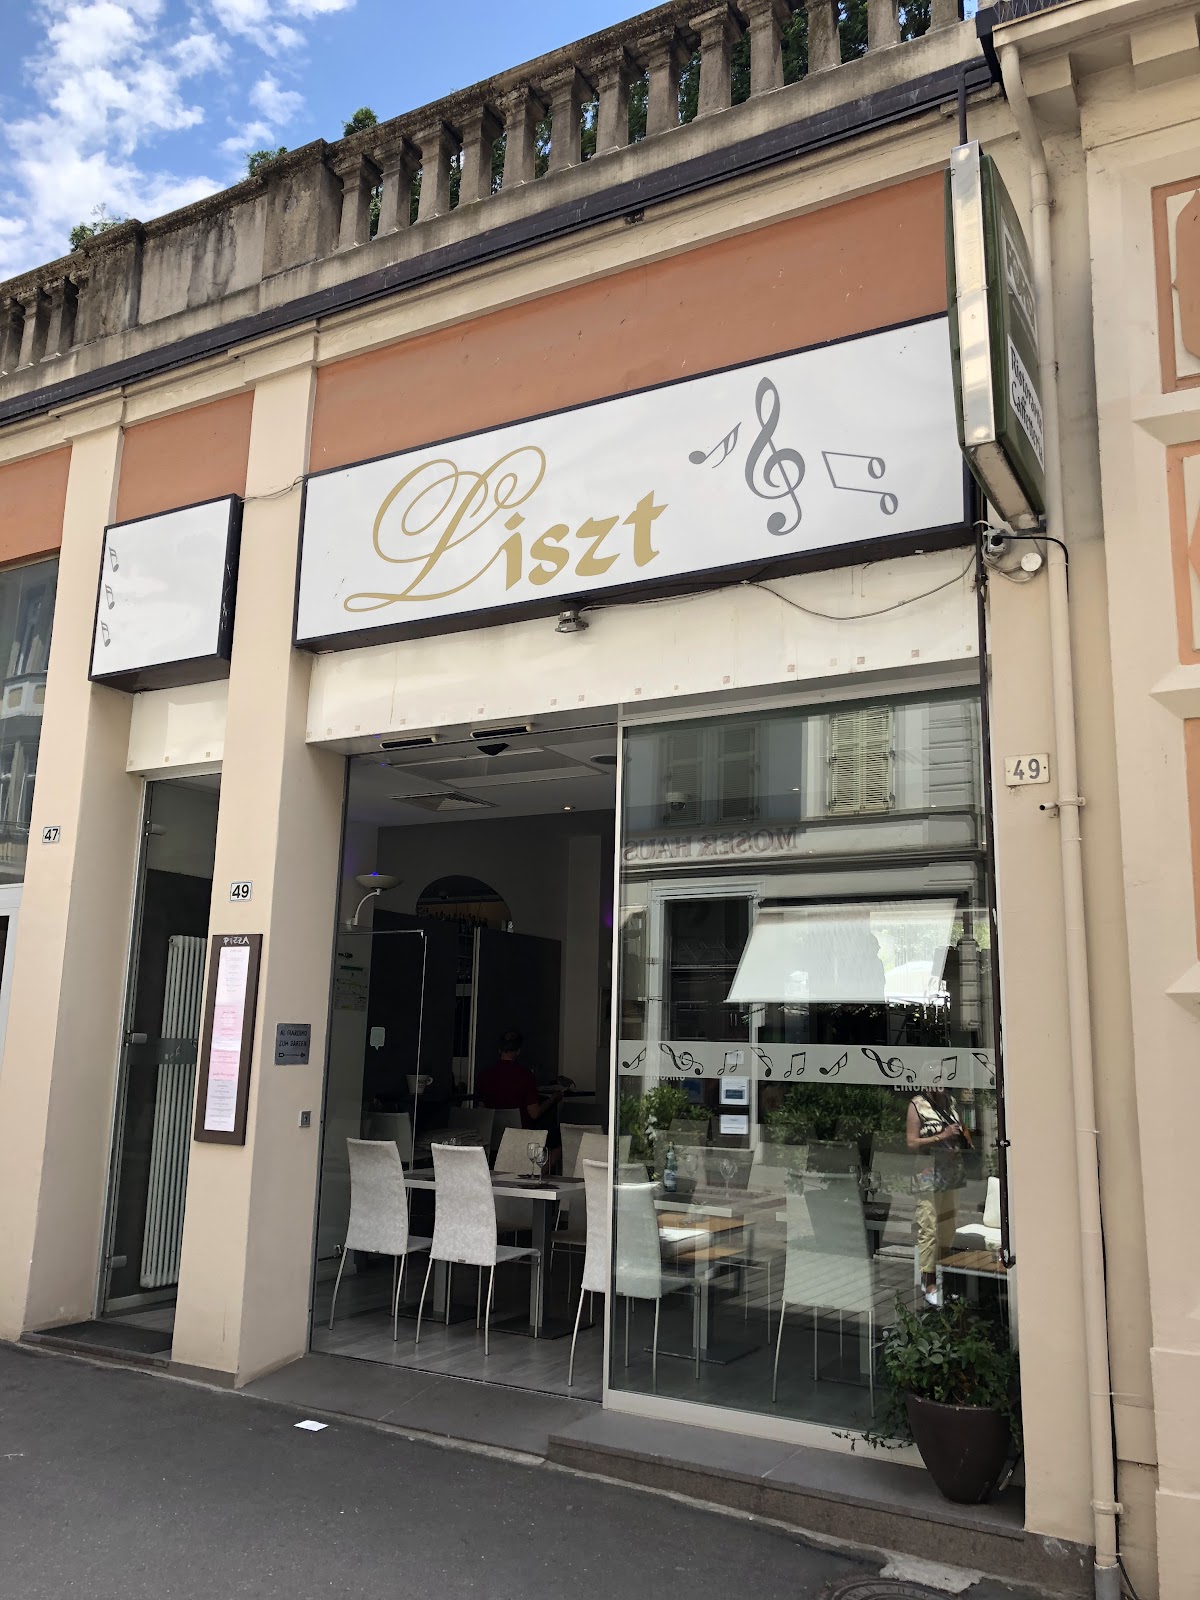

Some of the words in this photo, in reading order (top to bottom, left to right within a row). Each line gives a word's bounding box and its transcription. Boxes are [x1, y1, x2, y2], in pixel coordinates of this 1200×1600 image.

[1010, 346, 1043, 434] Ristorante
[343, 445, 670, 613] Liszt
[1013, 758, 1040, 780] 49
[44, 828, 59, 841] 47
[231, 884, 250, 899] 49
[223, 936, 250, 946] PIZZA
